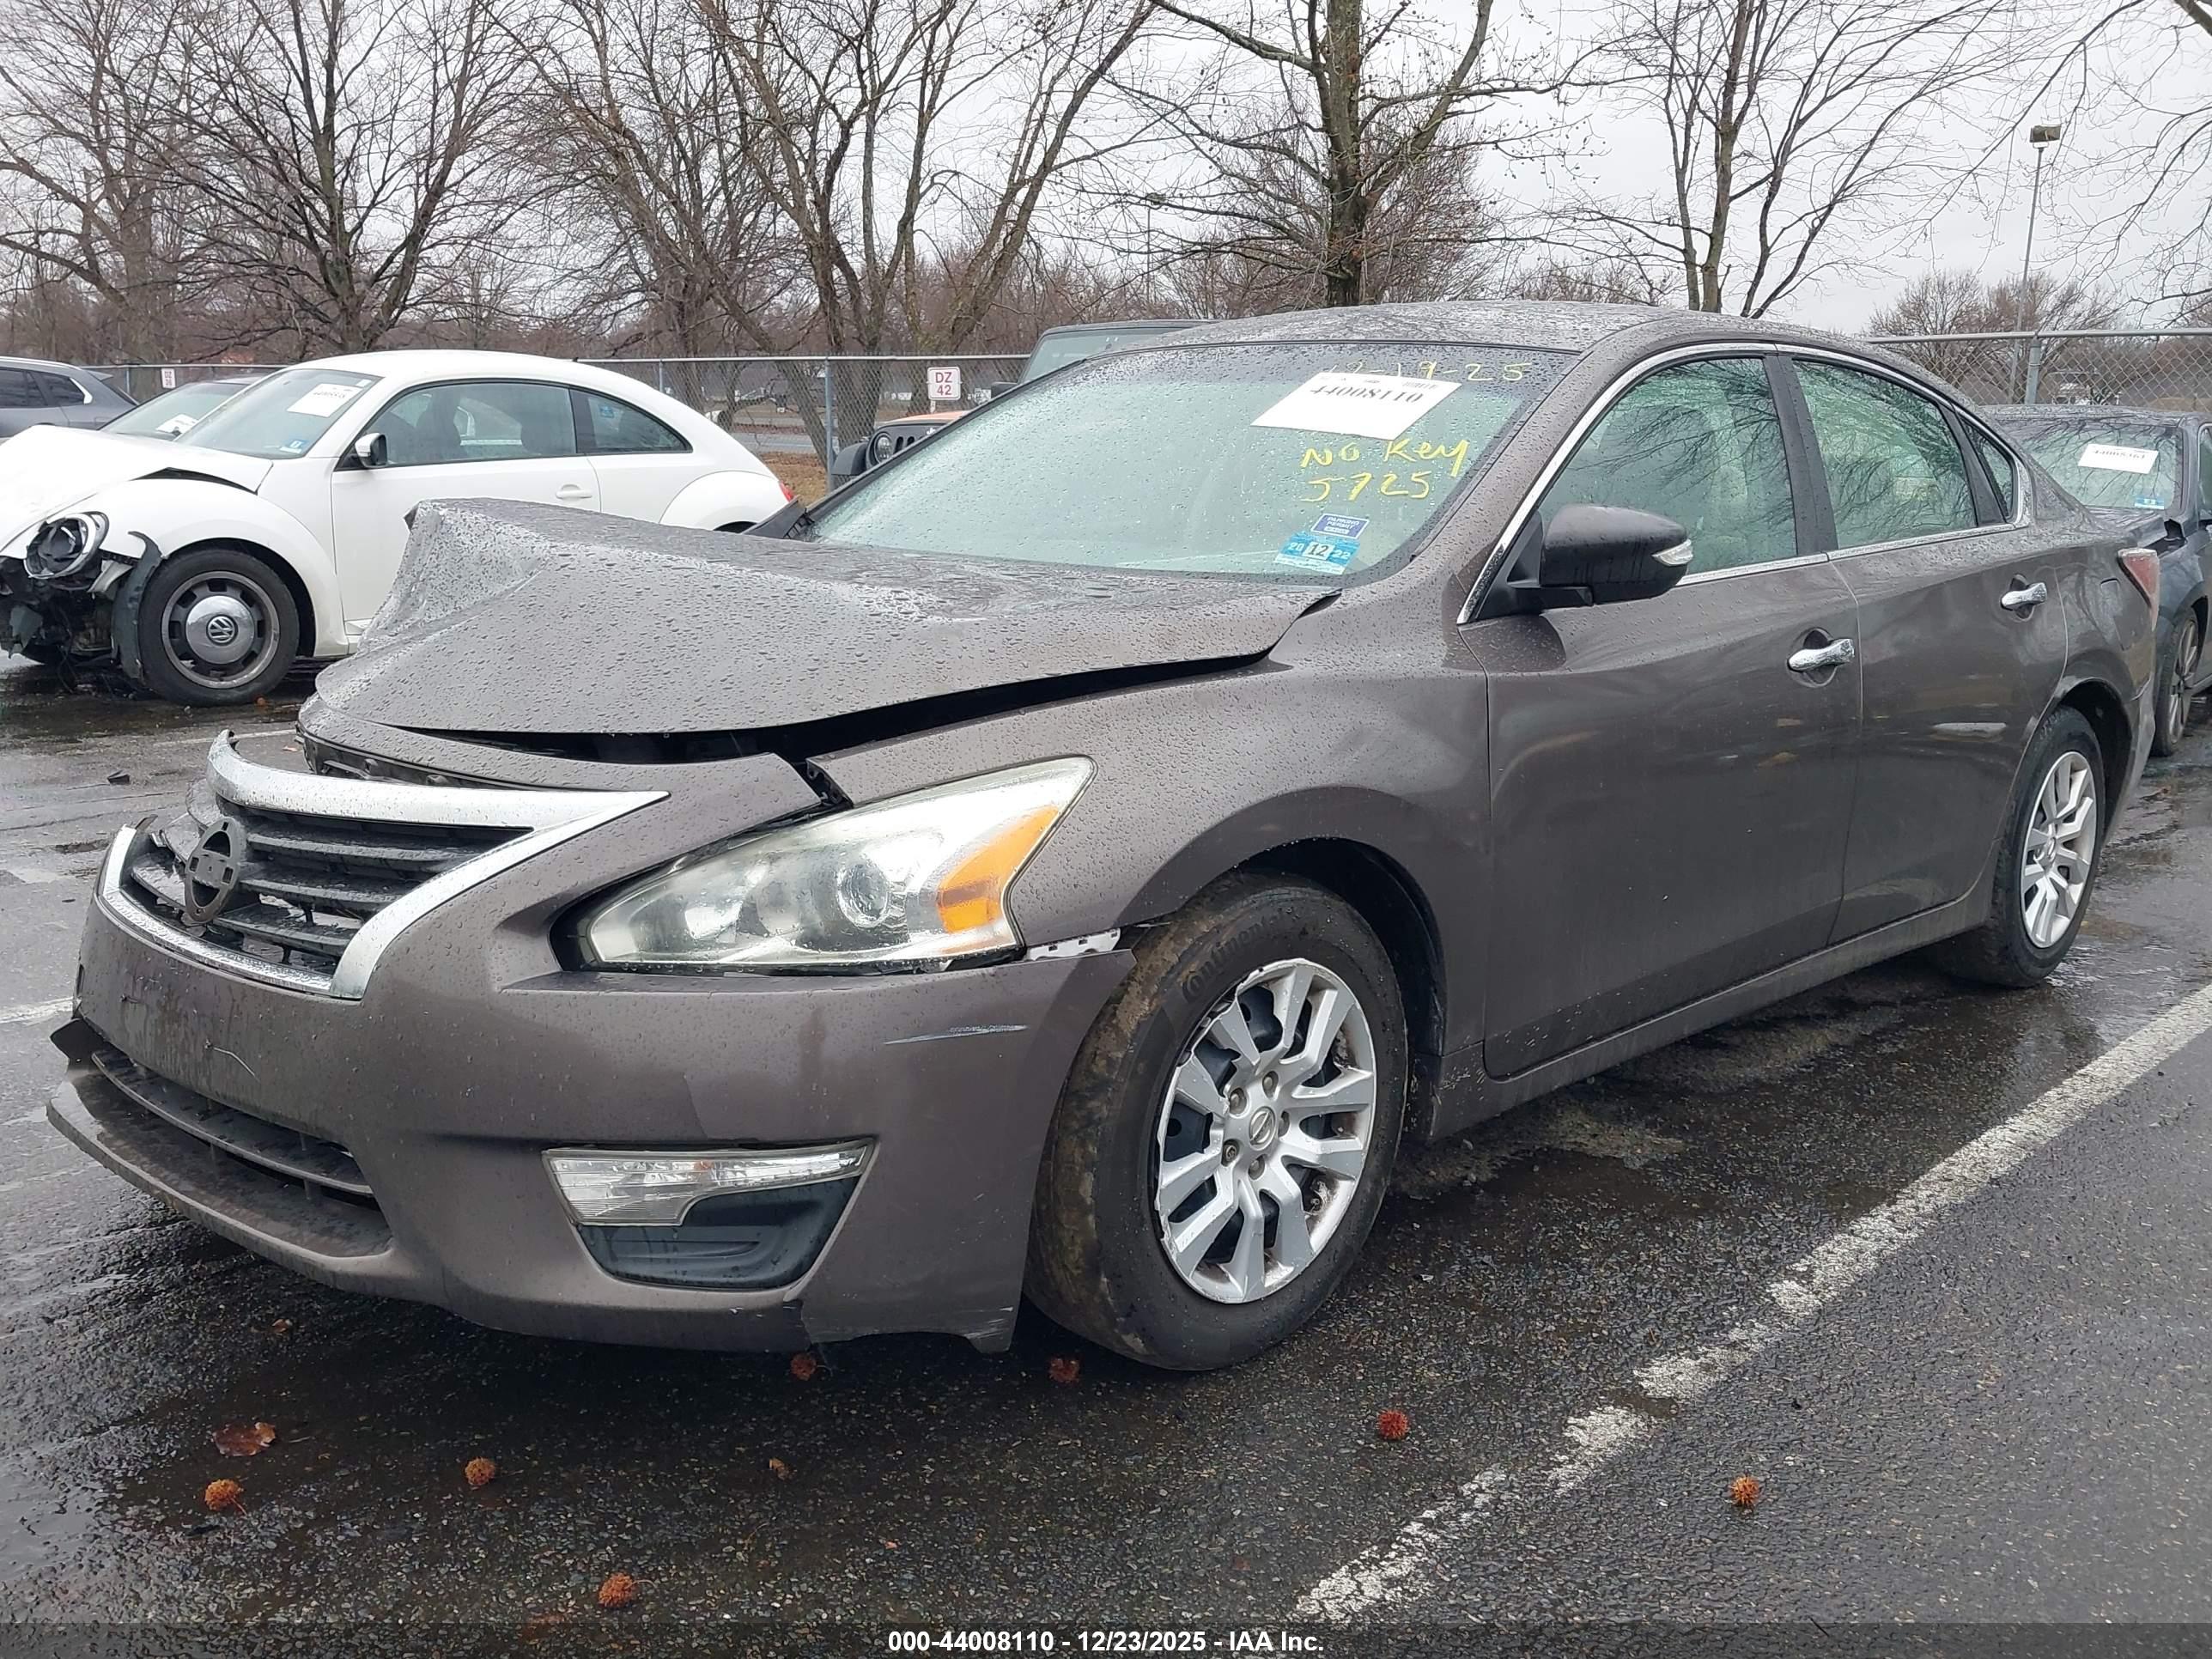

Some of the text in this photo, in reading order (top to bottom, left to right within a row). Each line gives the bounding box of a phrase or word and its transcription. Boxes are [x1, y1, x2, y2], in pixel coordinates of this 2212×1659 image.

[935, 372, 953, 384] DZ
[937, 385, 952, 396] 42
[1310, 385, 1425, 404] 44008110
[1288, 542, 1352, 560] 20 12 22
